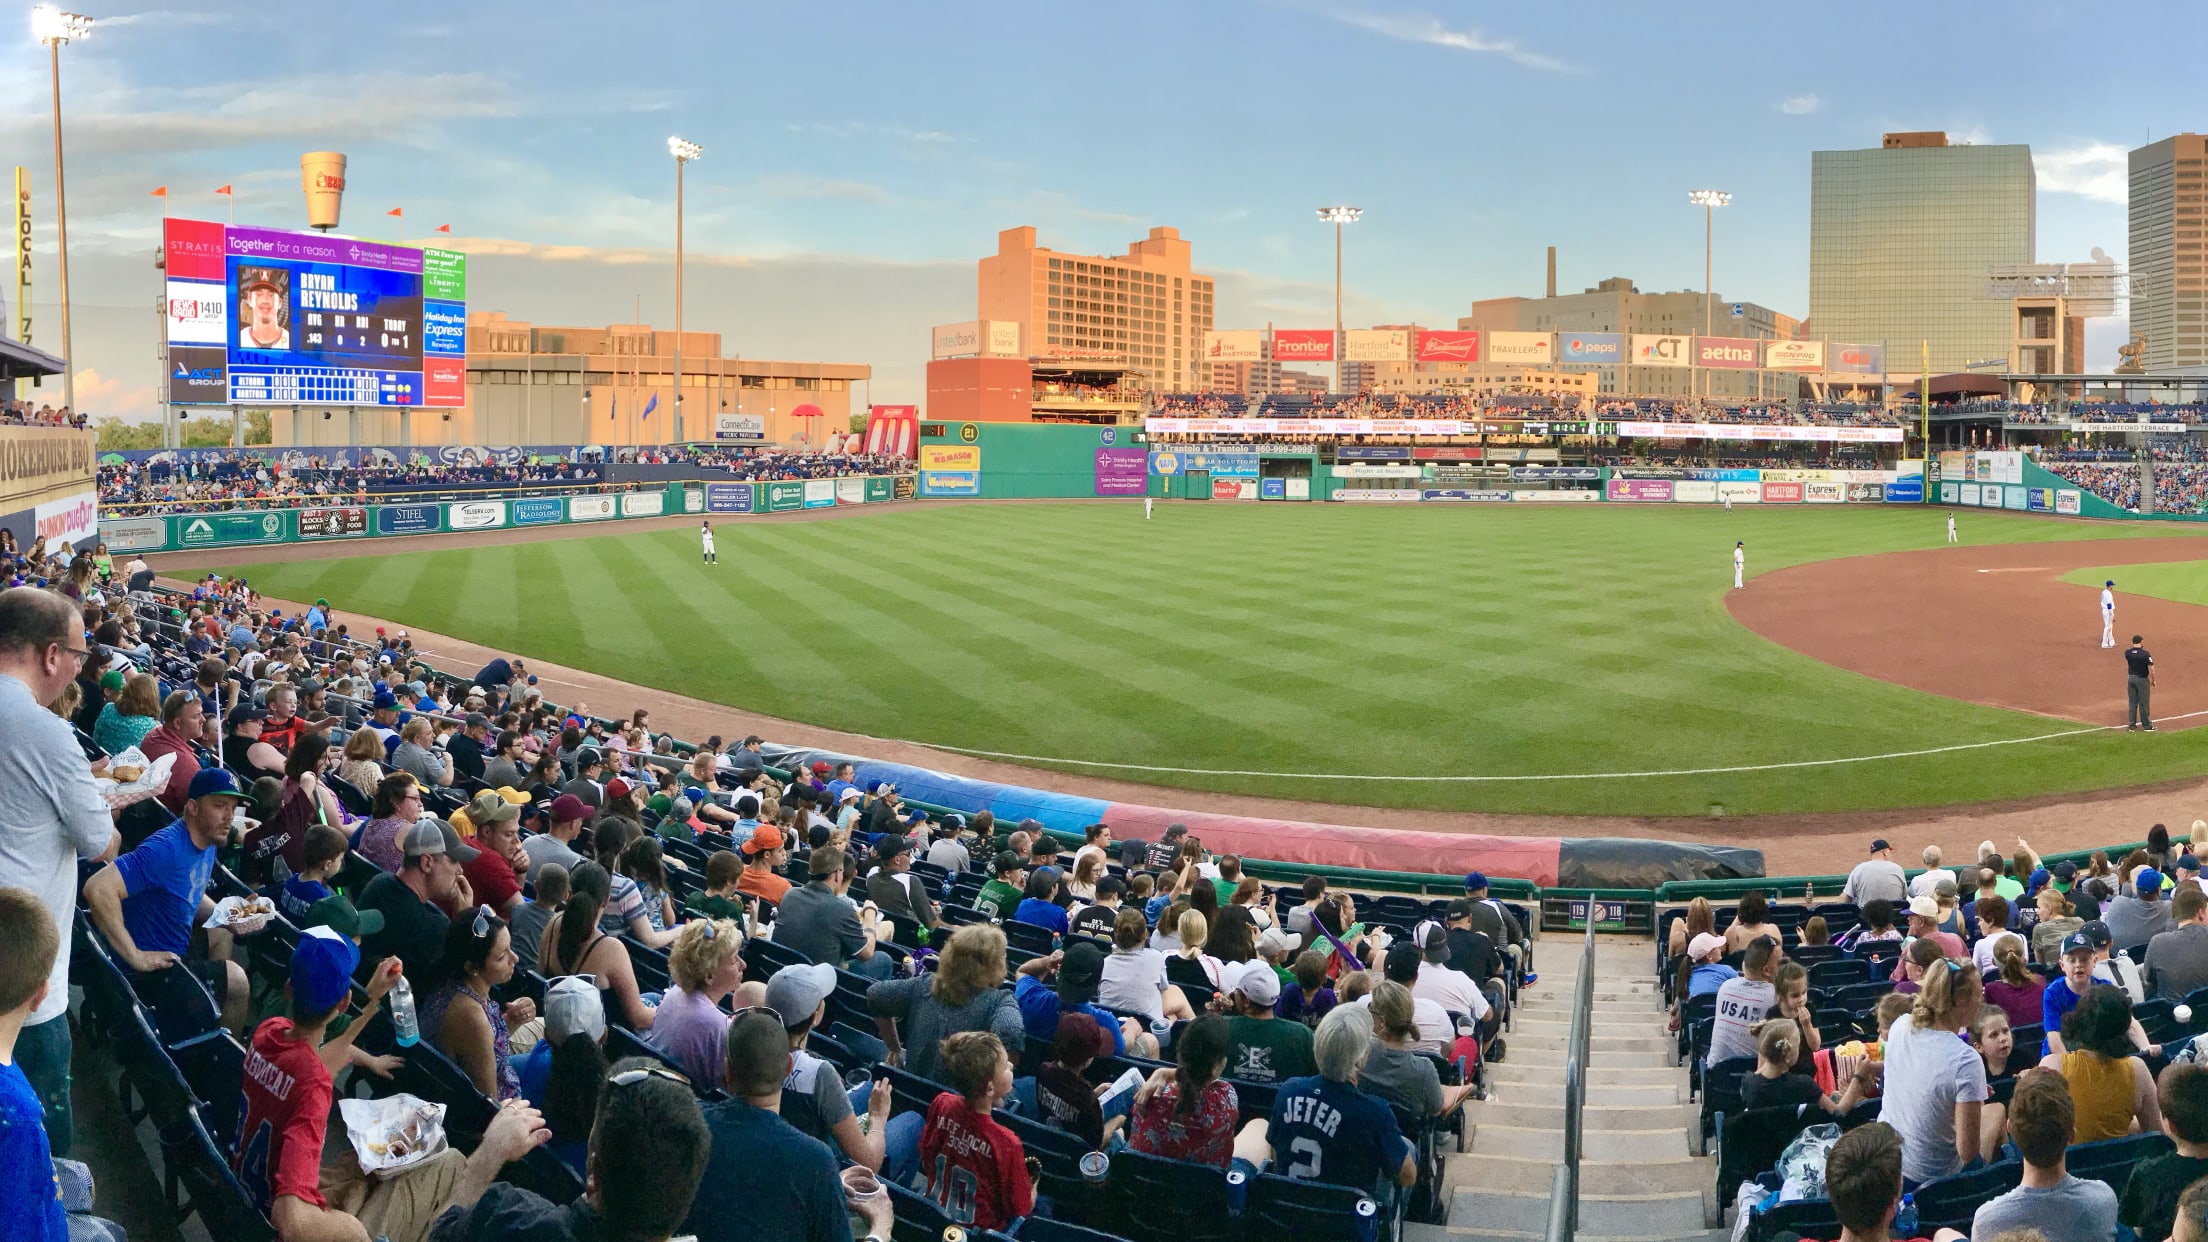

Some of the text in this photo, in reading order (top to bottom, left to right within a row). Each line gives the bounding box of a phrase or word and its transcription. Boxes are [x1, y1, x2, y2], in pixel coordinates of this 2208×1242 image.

[21, 202, 32, 286] LOCAL
[170, 240, 222, 252] STRATIS
[228, 237, 274, 253] Together
[277, 243, 290, 254] for
[304, 246, 336, 258] reason.
[300, 272, 335, 291] BRYAN
[172, 300, 195, 309] NEWS
[300, 290, 358, 311] REYNOLDS
[172, 308, 195, 317] RADIO
[200, 302, 222, 314] 1410
[308, 314, 322, 326] AVG
[335, 316, 345, 327] HR
[384, 319, 406, 332] TODAY
[425, 312, 454, 324] Holiday
[425, 323, 463, 336] Express
[306, 333, 322, 344] .143
[337, 335, 343, 345] 0
[360, 336, 366, 346] 2
[381, 334, 388, 347] 0
[402, 335, 408, 348] 1
[432, 341, 458, 349] Newington
[1277, 340, 1330, 352] Frontier
[1350, 341, 1389, 350] Hartford
[1428, 342, 1470, 352] Budweiser
[1491, 345, 1538, 354] TRAVELERS
[1585, 342, 1616, 354] pepsi
[1656, 338, 1682, 357] CT
[1702, 344, 1753, 362] aetna
[1350, 350, 1401, 359] HealthCare
[189, 368, 222, 378] ACT
[721, 418, 760, 430] ConnectiCare
[964, 428, 975, 438] 21
[1102, 431, 1113, 440] 42
[72, 439, 89, 475] BBQ
[1159, 459, 1174, 468] NAPA
[1690, 470, 1739, 480] STRATIS
[1766, 486, 1798, 494] HARTFORD
[1807, 484, 1837, 494] Express
[396, 508, 423, 520] STIFEL
[516, 504, 553, 514] JEFFERSON
[520, 510, 561, 519] RADIOLOGY
[1573, 905, 1584, 916] 119
[1721, 1000, 1748, 1020] USA
[1249, 1047, 1260, 1068] E
[1283, 1096, 1342, 1138] JETER
[962, 1130, 992, 1158] LOCAL
[1288, 1136, 1322, 1180] 2
